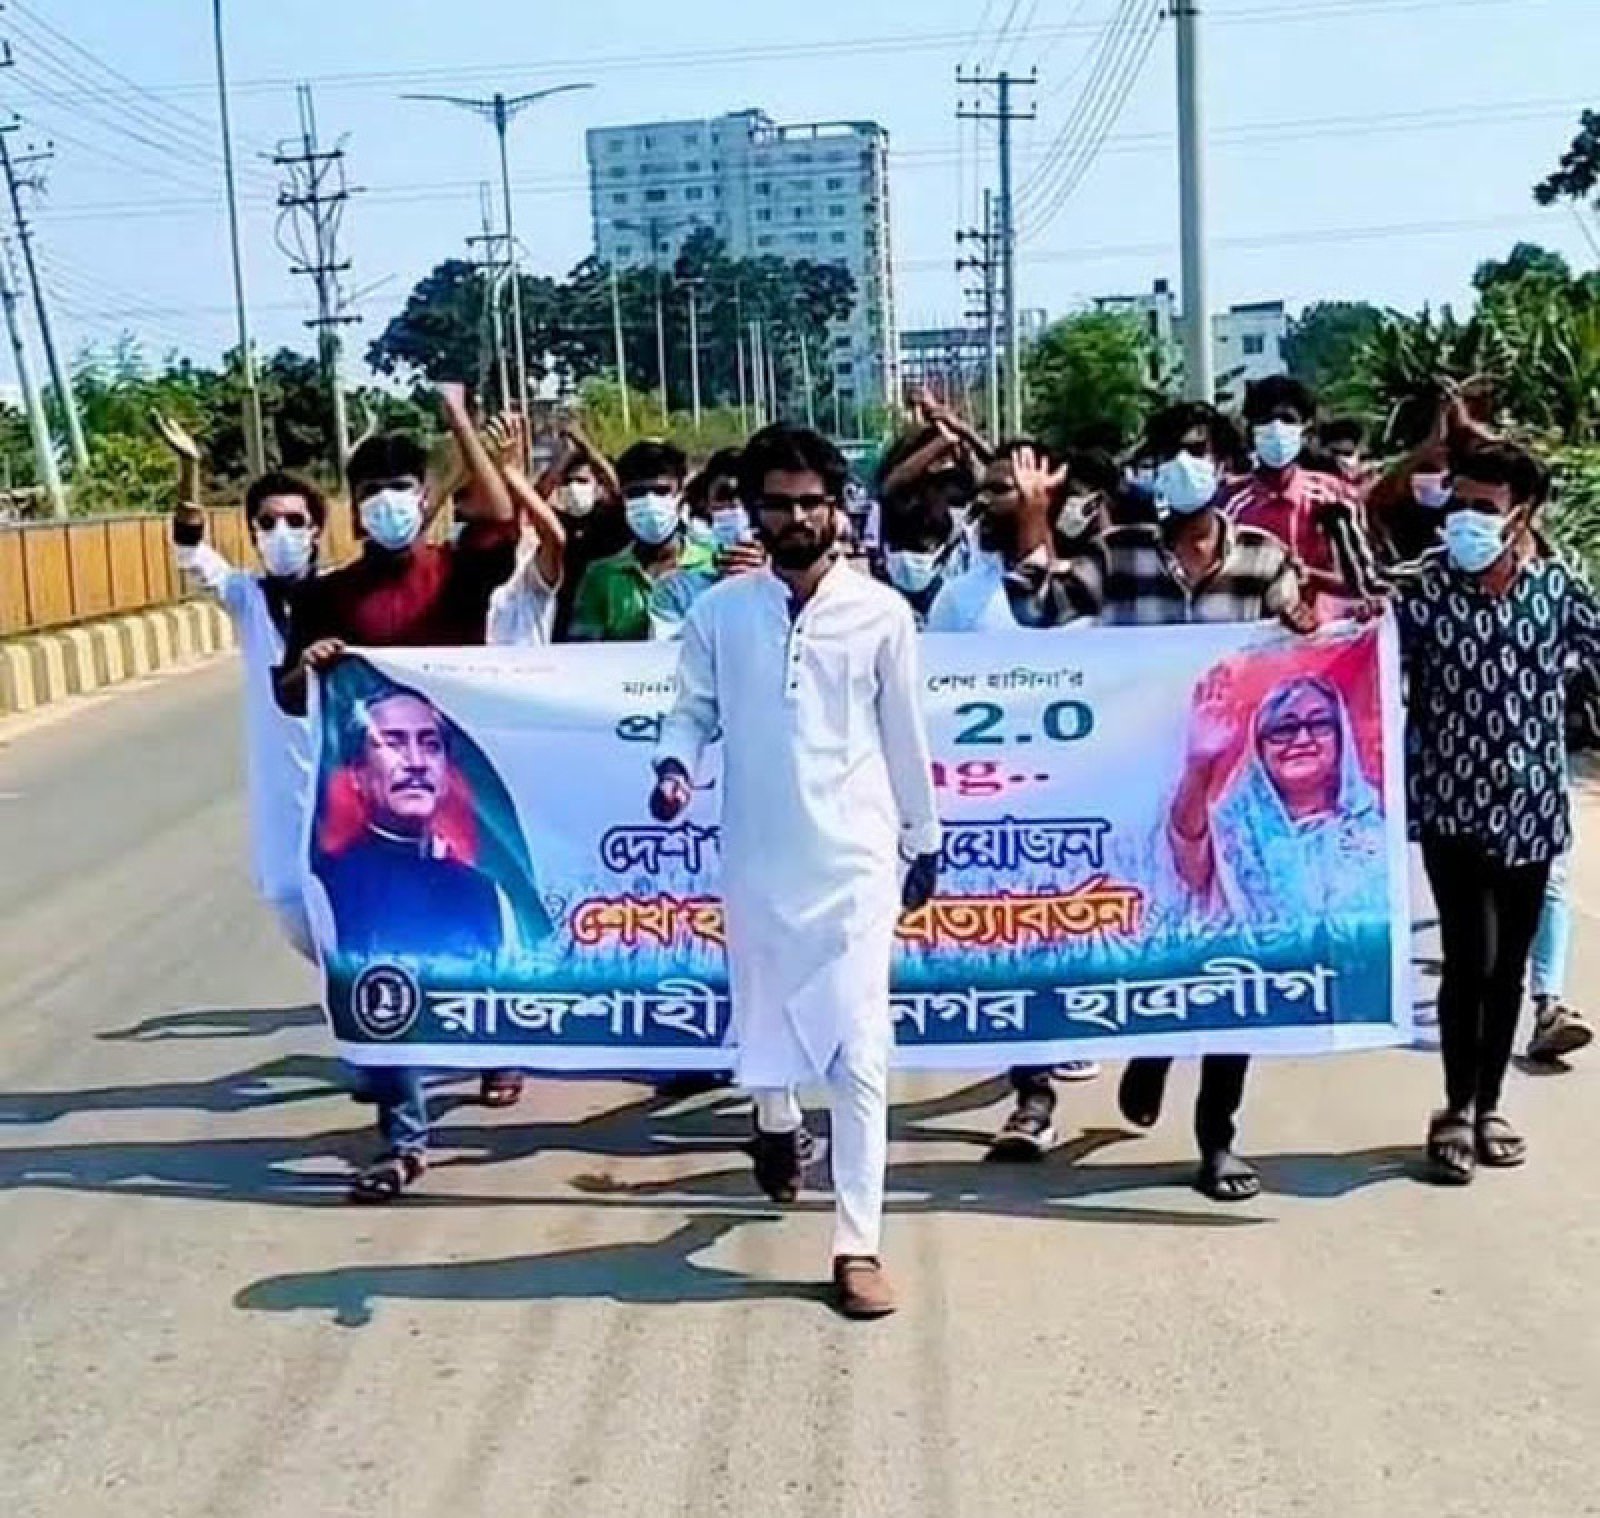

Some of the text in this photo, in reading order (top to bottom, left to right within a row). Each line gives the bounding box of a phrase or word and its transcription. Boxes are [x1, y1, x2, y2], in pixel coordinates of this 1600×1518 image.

[953, 700, 1095, 745] 2.0
[425, 957, 1338, 1039] রাজশাহী নগর ছাত্রলীগ
